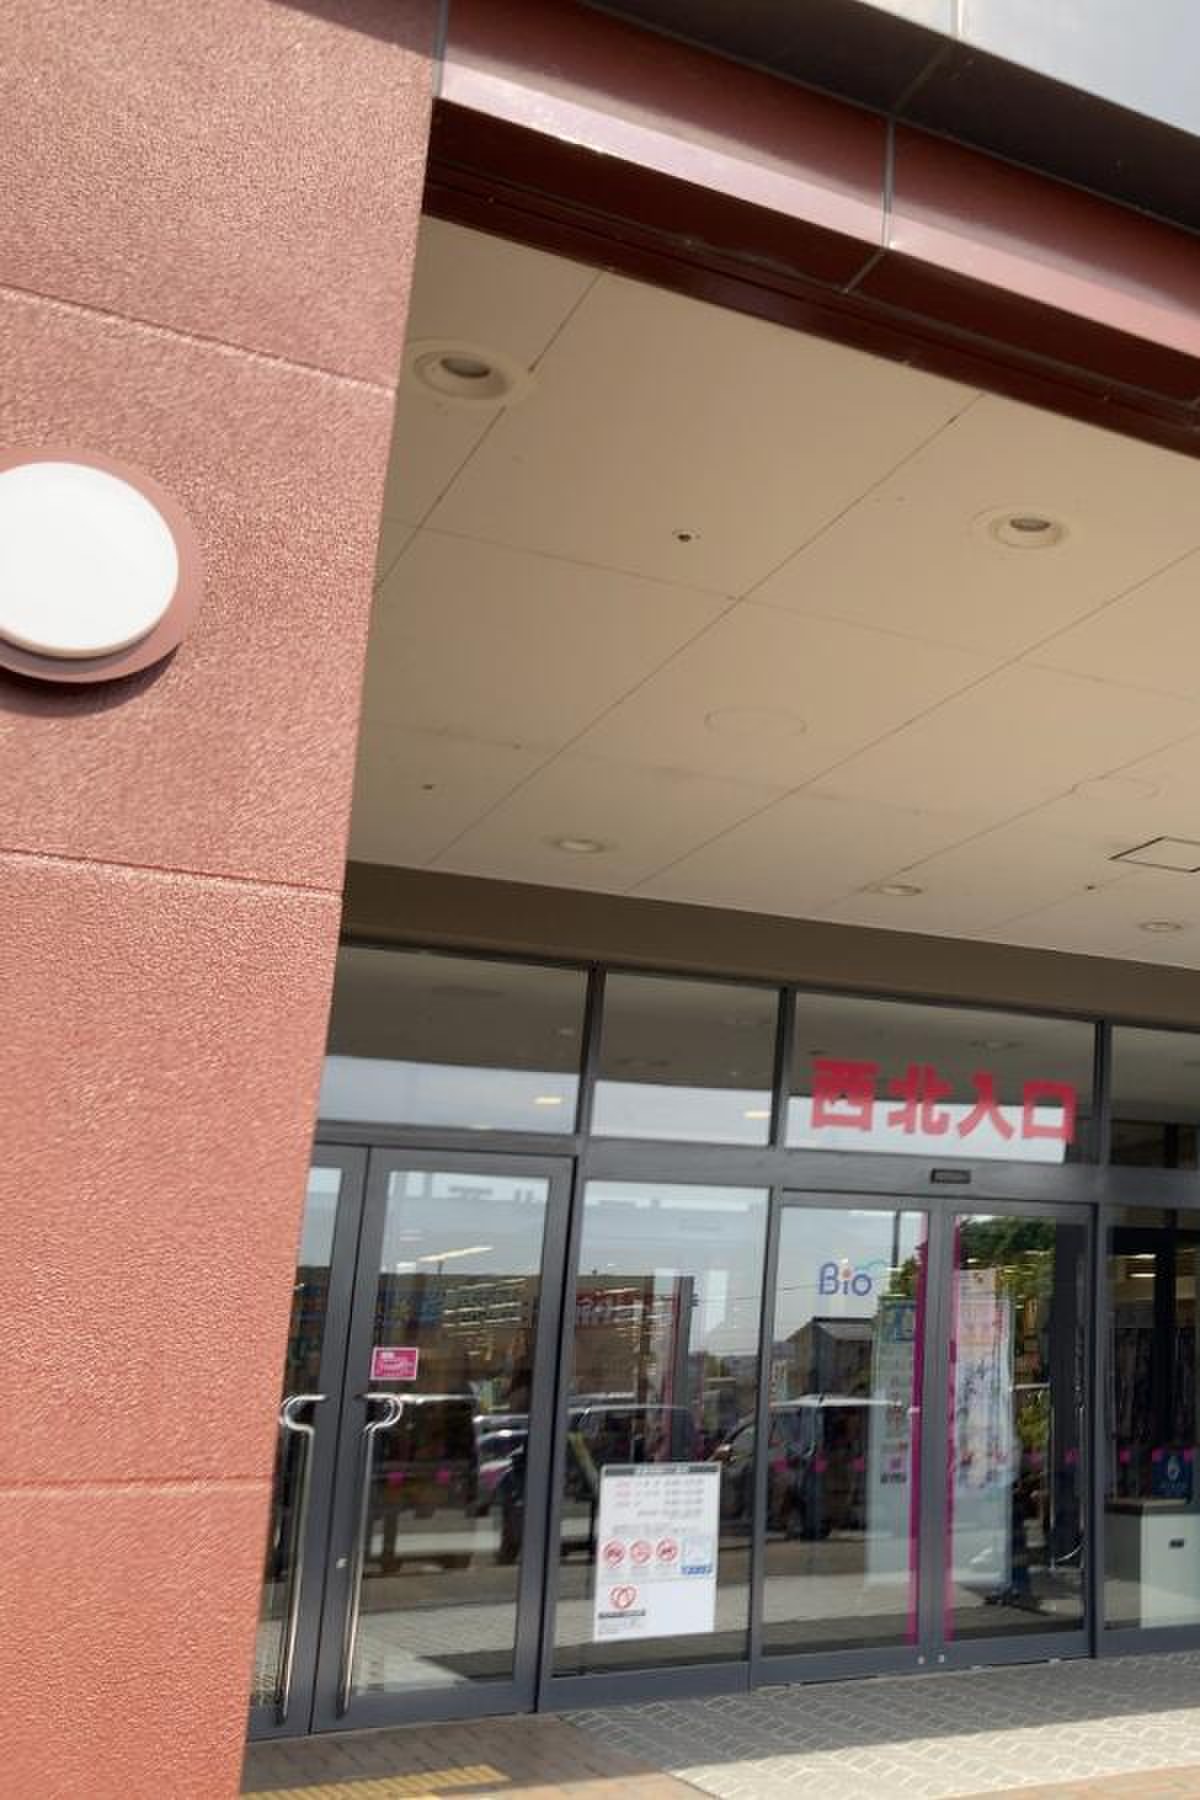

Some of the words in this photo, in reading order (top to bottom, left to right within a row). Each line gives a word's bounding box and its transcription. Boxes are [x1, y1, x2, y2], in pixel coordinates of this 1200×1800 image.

[810, 1059, 1076, 1145] 西北入口
[819, 1262, 872, 1296] Bio
